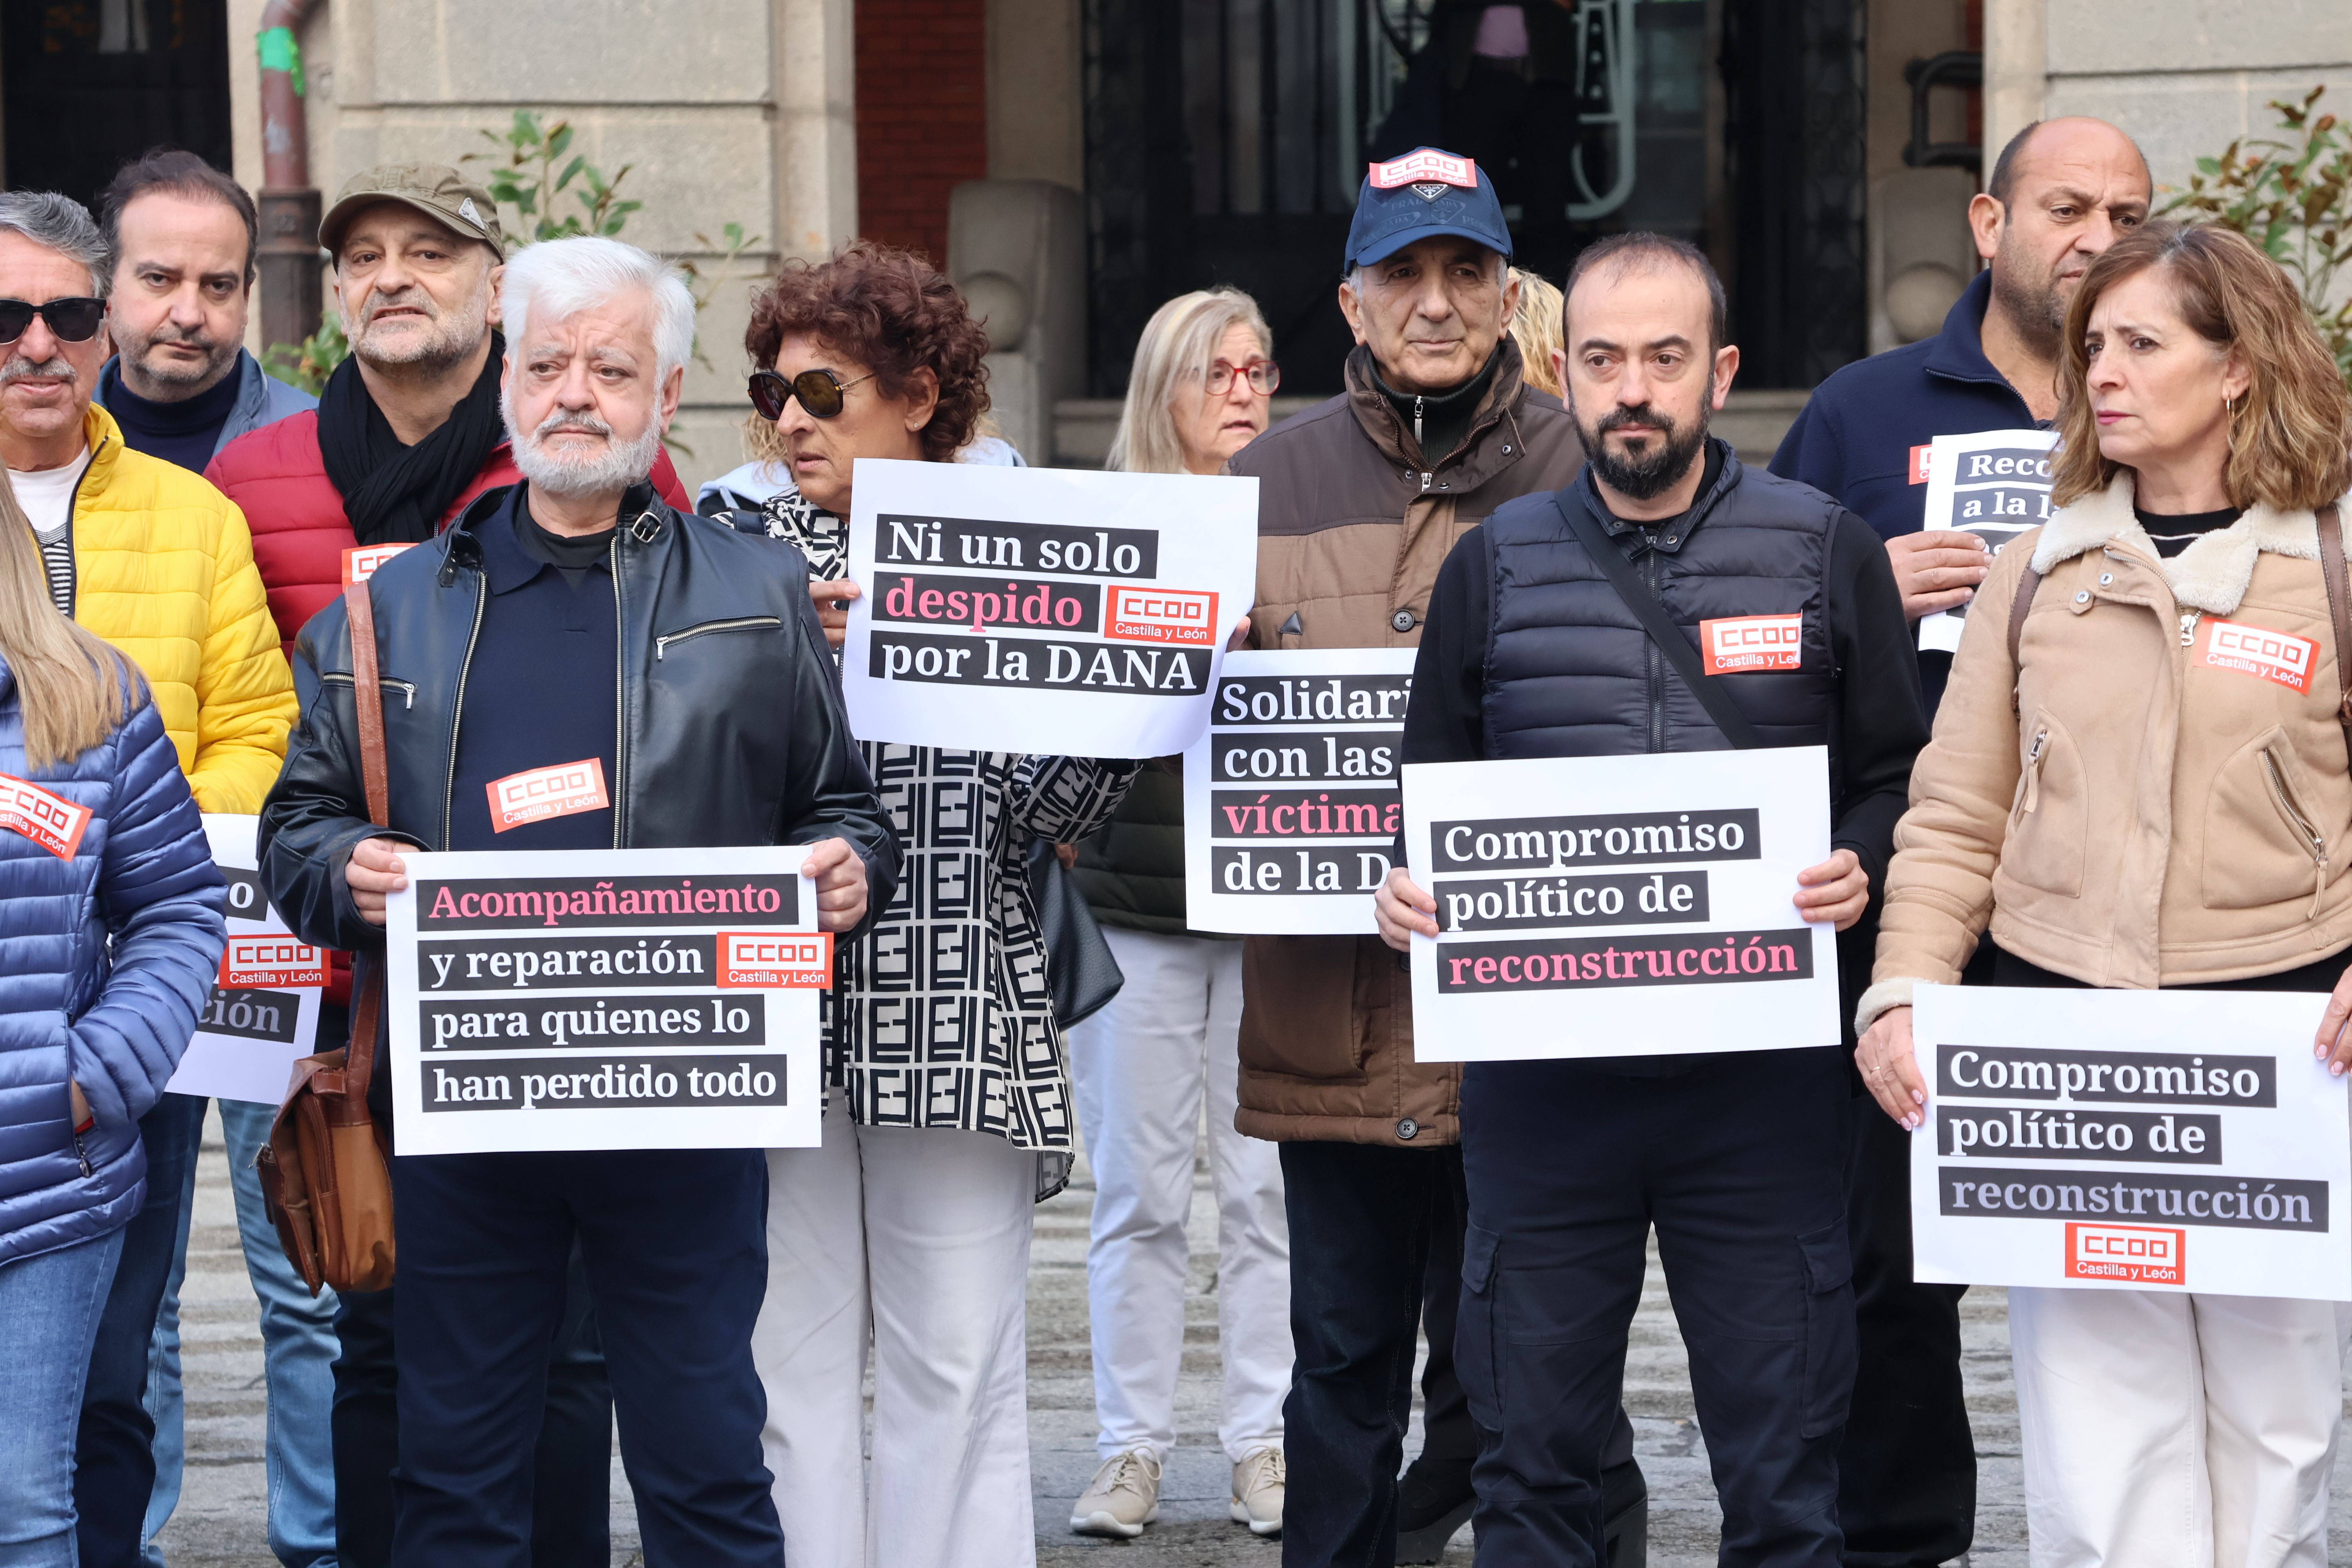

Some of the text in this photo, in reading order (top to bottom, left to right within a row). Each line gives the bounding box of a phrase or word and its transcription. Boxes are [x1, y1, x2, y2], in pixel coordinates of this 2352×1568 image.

[1380, 171, 1425, 185] Castilla
[1438, 171, 1467, 184] León
[1387, 157, 1458, 176] CCOO
[1963, 500, 1982, 517] a
[1992, 491, 2027, 515] la
[887, 521, 1141, 574] Ni un solo
[886, 577, 1082, 633] despido
[1124, 598, 1201, 619] CCOO
[1115, 622, 1207, 640] Castilla y León
[1721, 626, 1799, 647] CCOO
[2218, 630, 2302, 665] CCOO
[882, 640, 1197, 690] por la DANA
[1716, 653, 1797, 668] Castilla y Le
[2206, 653, 2303, 687] Castilla y León
[1225, 737, 1393, 778] con las
[506, 771, 586, 804] CCOO
[503, 795, 598, 824] Castilla y León
[1222, 794, 1401, 834] víctima
[29, 826, 38, 837] y
[40, 829, 66, 854] León
[1445, 815, 1744, 868] Compromiso
[1224, 851, 1282, 891] de
[1296, 851, 1342, 891] la
[429, 880, 780, 926] Acompañamiento
[1446, 875, 1694, 931] político de
[237, 946, 313, 963] CCOO
[429, 940, 704, 988] y reparación
[736, 944, 817, 962] CCOO
[1449, 936, 1798, 985] reconstrucción
[230, 970, 322, 985] Castilla y León
[728, 971, 825, 985] Castilla y León
[432, 1000, 750, 1049] para quienes lo
[434, 1063, 777, 1109] han perdido todo
[1950, 1051, 2260, 1102] Compromiso
[1949, 1111, 2206, 1156] político de
[1952, 1181, 2312, 1223] reconstrucción
[2085, 1236, 2167, 1258] CCOO
[2076, 1262, 2176, 1280] Castilla y León
